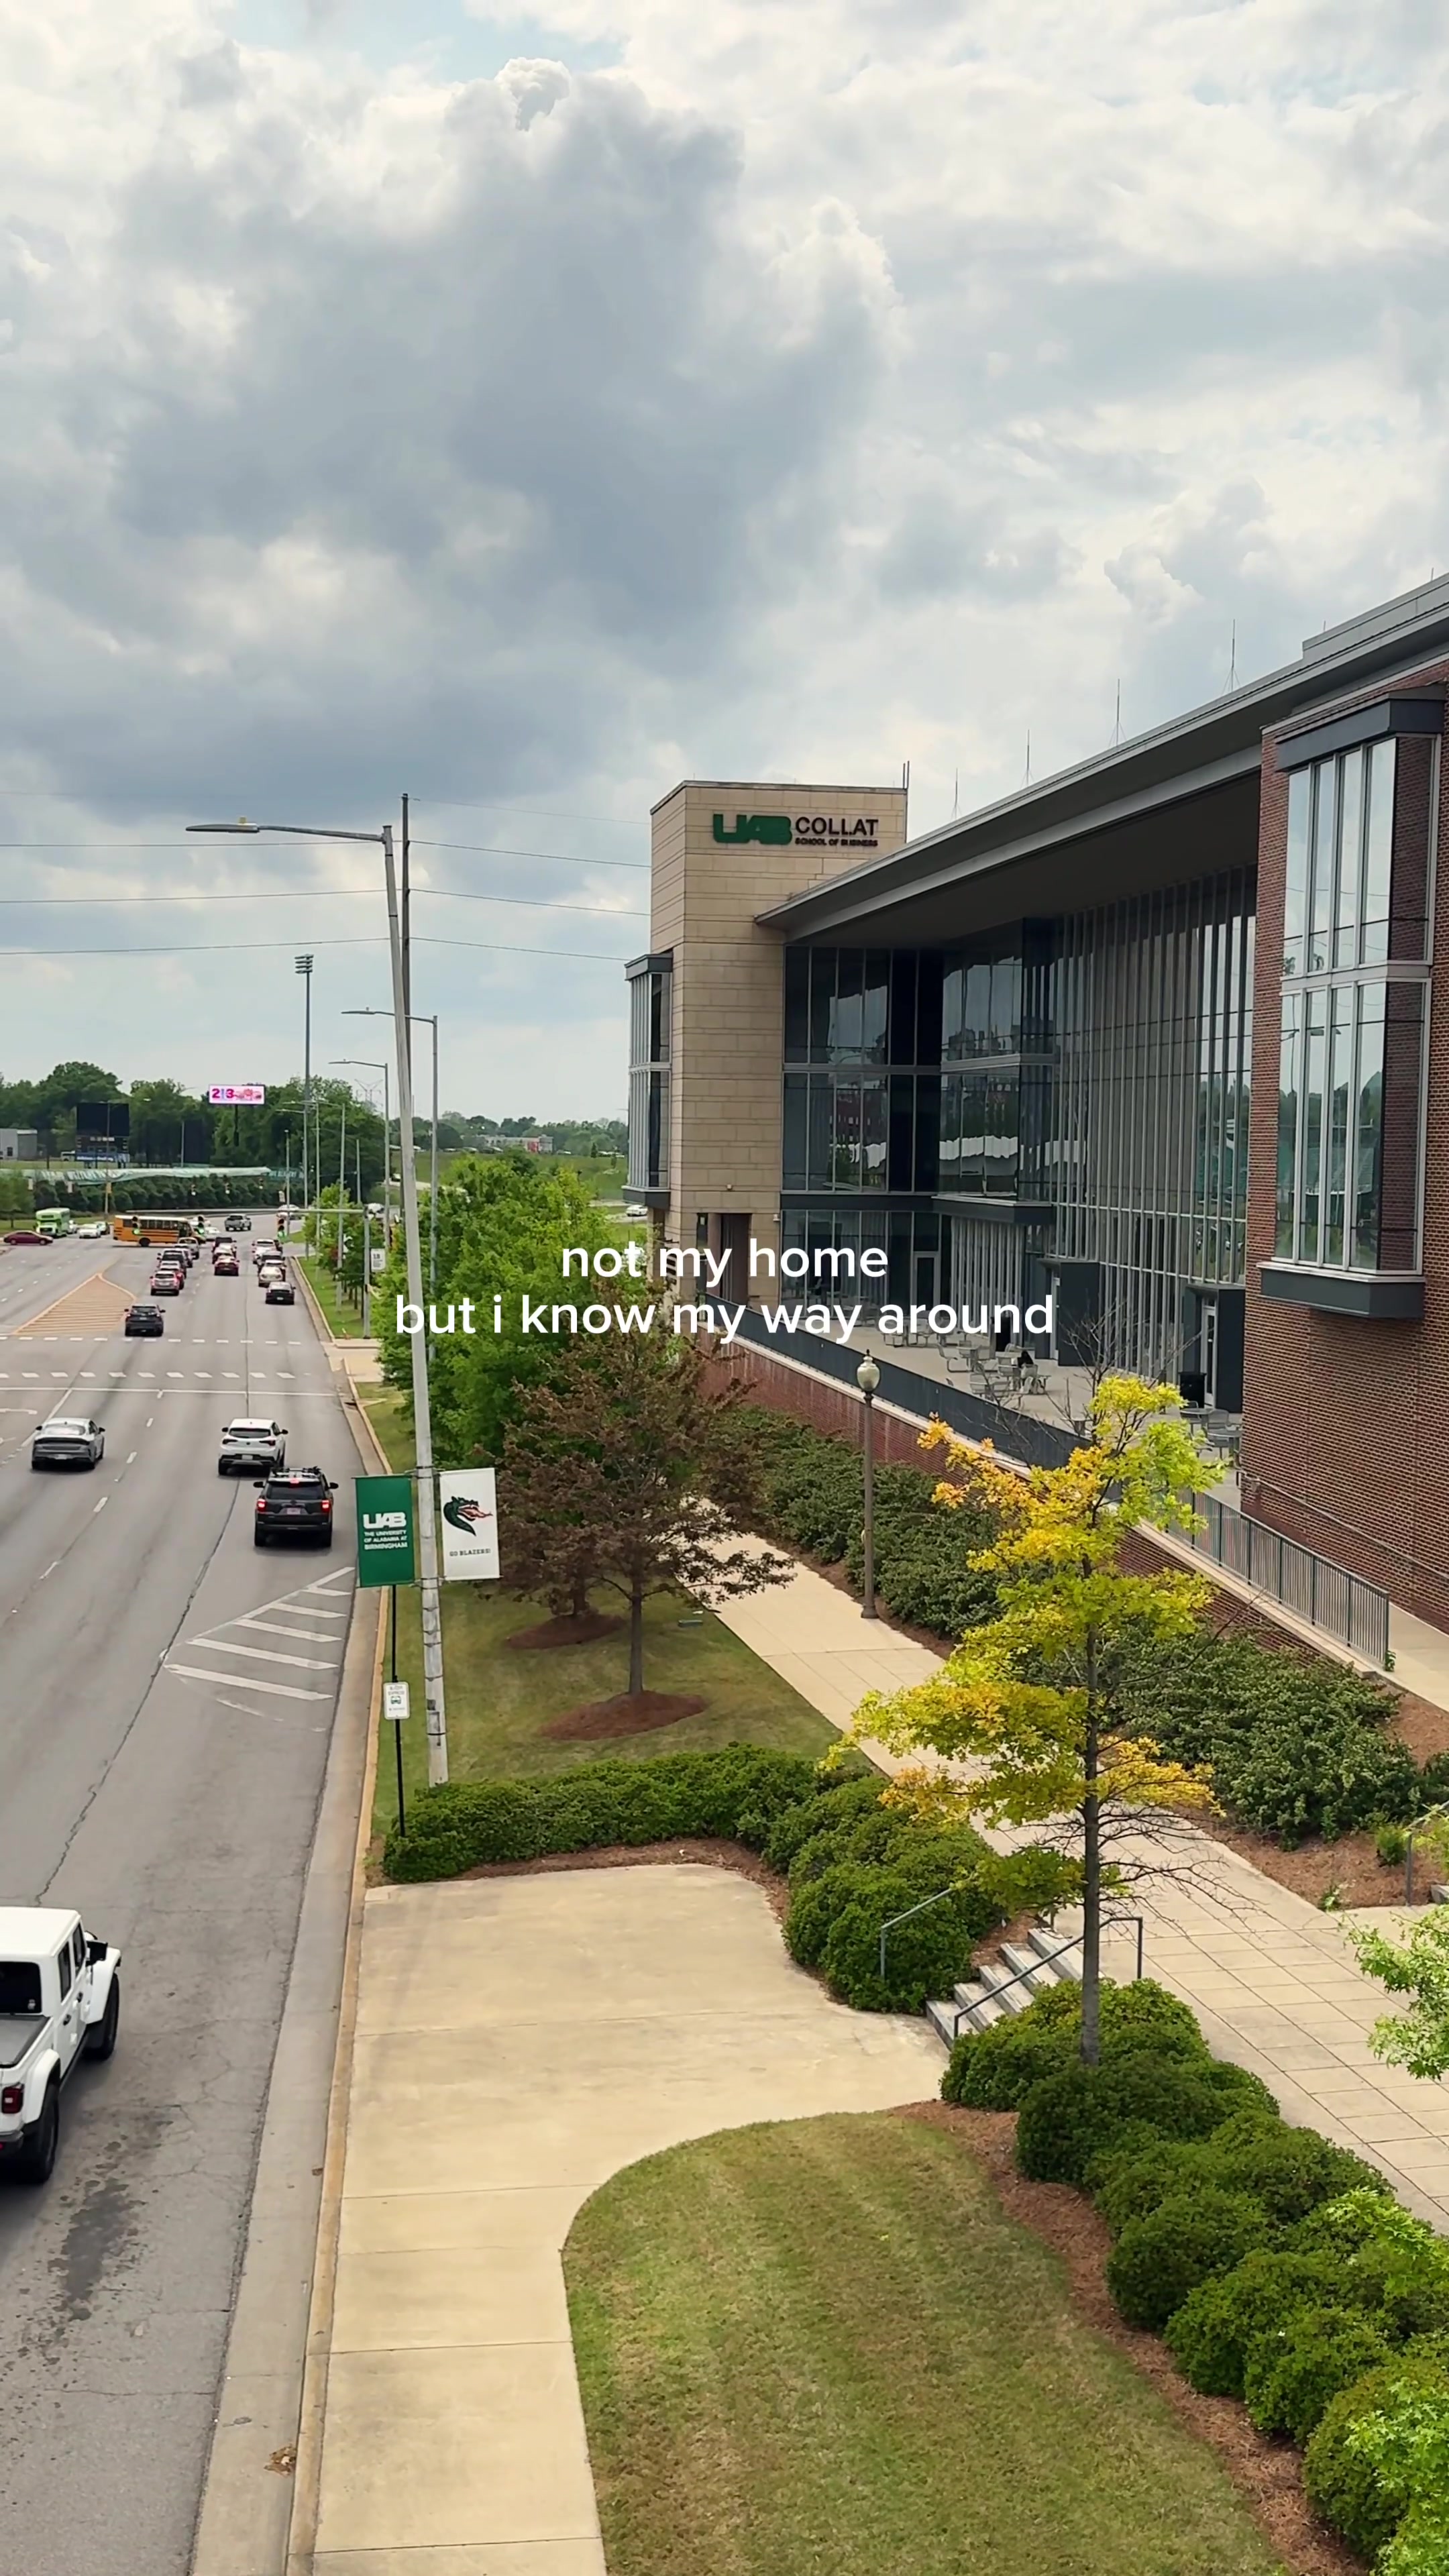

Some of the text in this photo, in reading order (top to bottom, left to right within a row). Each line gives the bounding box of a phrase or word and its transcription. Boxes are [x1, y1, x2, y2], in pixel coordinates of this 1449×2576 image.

[712, 814, 793, 845] UAB
[795, 816, 879, 836] COLLAT
[795, 837, 827, 846] SCHOOL
[363, 1512, 407, 1529] UAB
[364, 1542, 408, 1550] BIRMINGHAM
